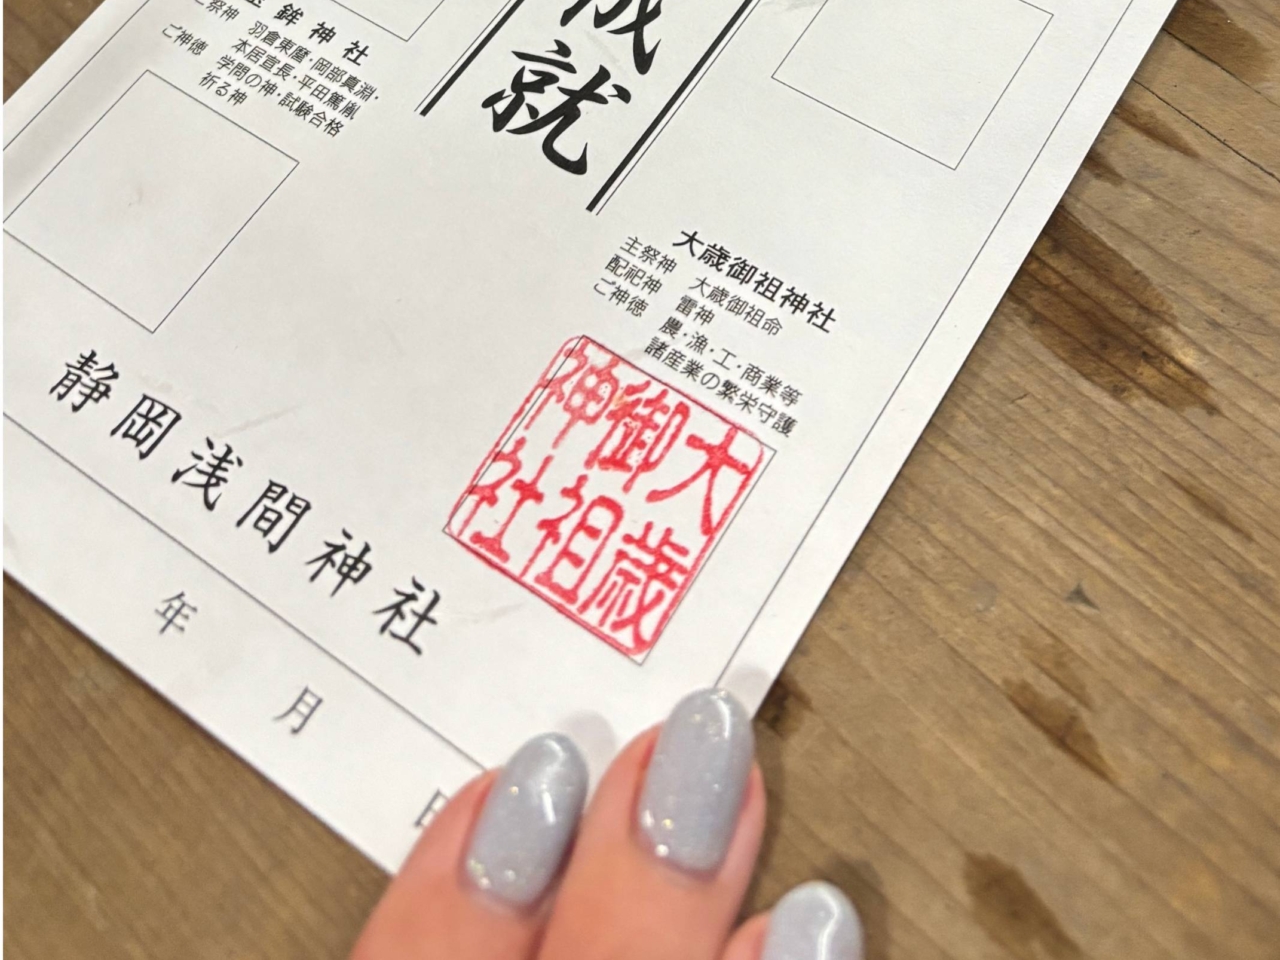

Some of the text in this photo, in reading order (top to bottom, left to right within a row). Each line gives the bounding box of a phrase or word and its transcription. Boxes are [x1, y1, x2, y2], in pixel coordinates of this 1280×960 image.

[161, 23, 346, 139] ご神徳 学問の神・試験合格
[198, 70, 249, 107] 祈る神
[231, 37, 362, 122] 本居宣長・平田篤胤
[593, 277, 650, 319] ご神徳
[604, 253, 716, 327] 配祀神 雷神
[619, 236, 784, 337] 主祭神 大歳御祖命
[672, 230, 837, 334] 大歳御祖神社
[644, 336, 798, 439] 諸産業の繁栄守護
[48, 349, 442, 656] 静岡浅間神社
[154, 591, 323, 736] 年 月
